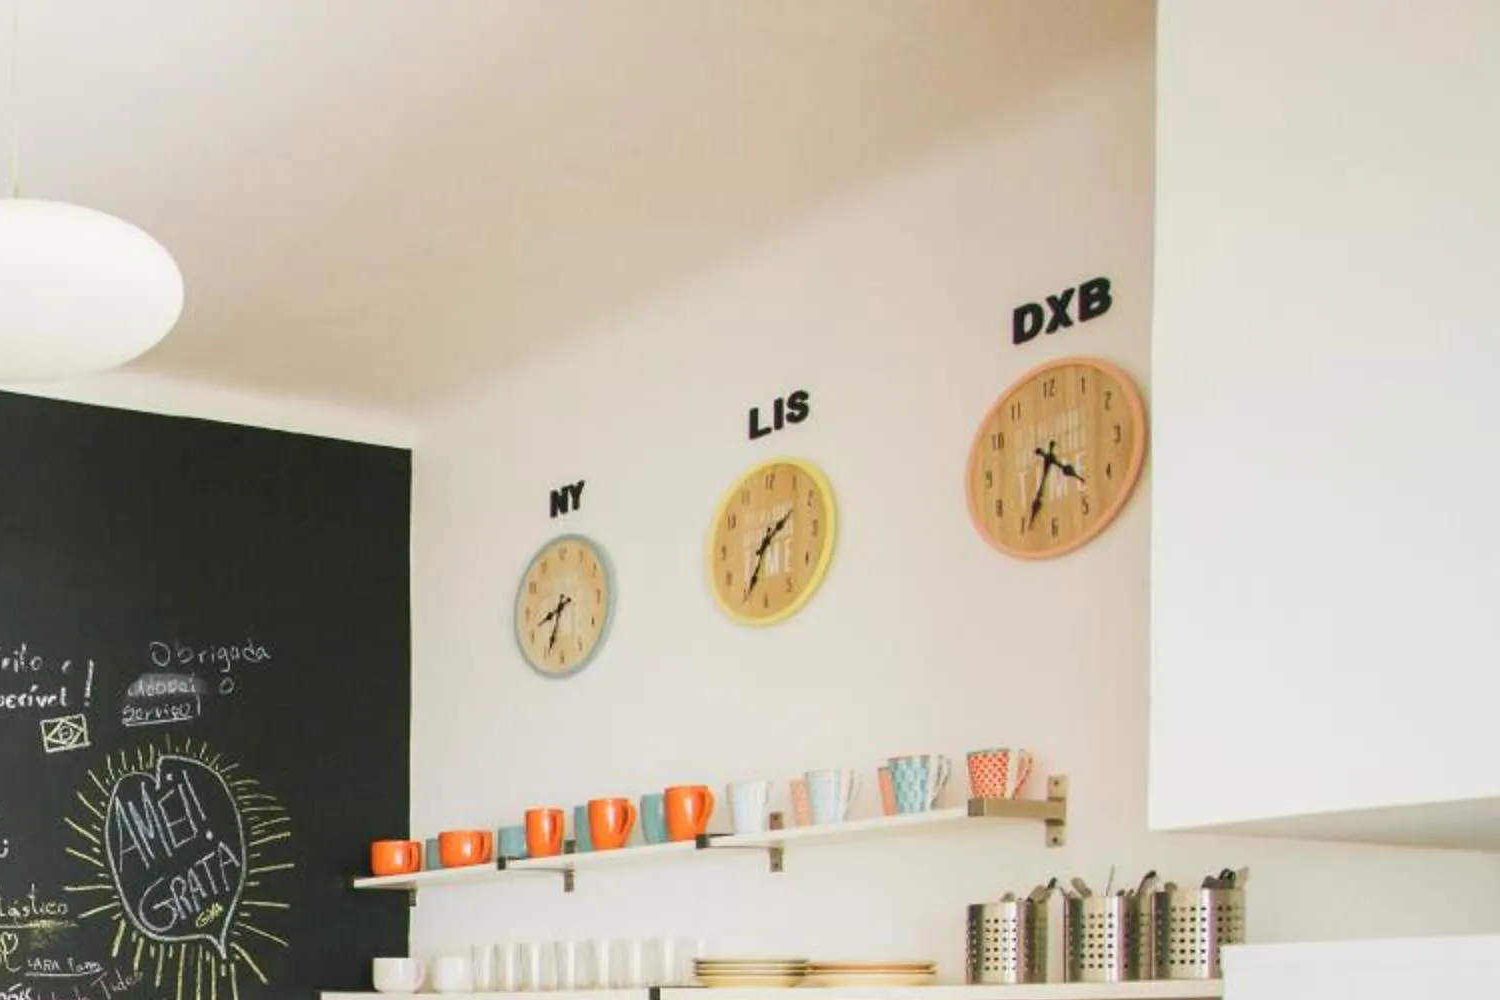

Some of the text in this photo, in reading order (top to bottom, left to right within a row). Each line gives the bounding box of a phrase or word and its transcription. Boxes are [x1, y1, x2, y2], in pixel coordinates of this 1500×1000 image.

[1012, 276, 1113, 345] DXB
[748, 389, 810, 440] LIS
[549, 480, 585, 518] NY
[139, 841, 240, 932] GRATA
